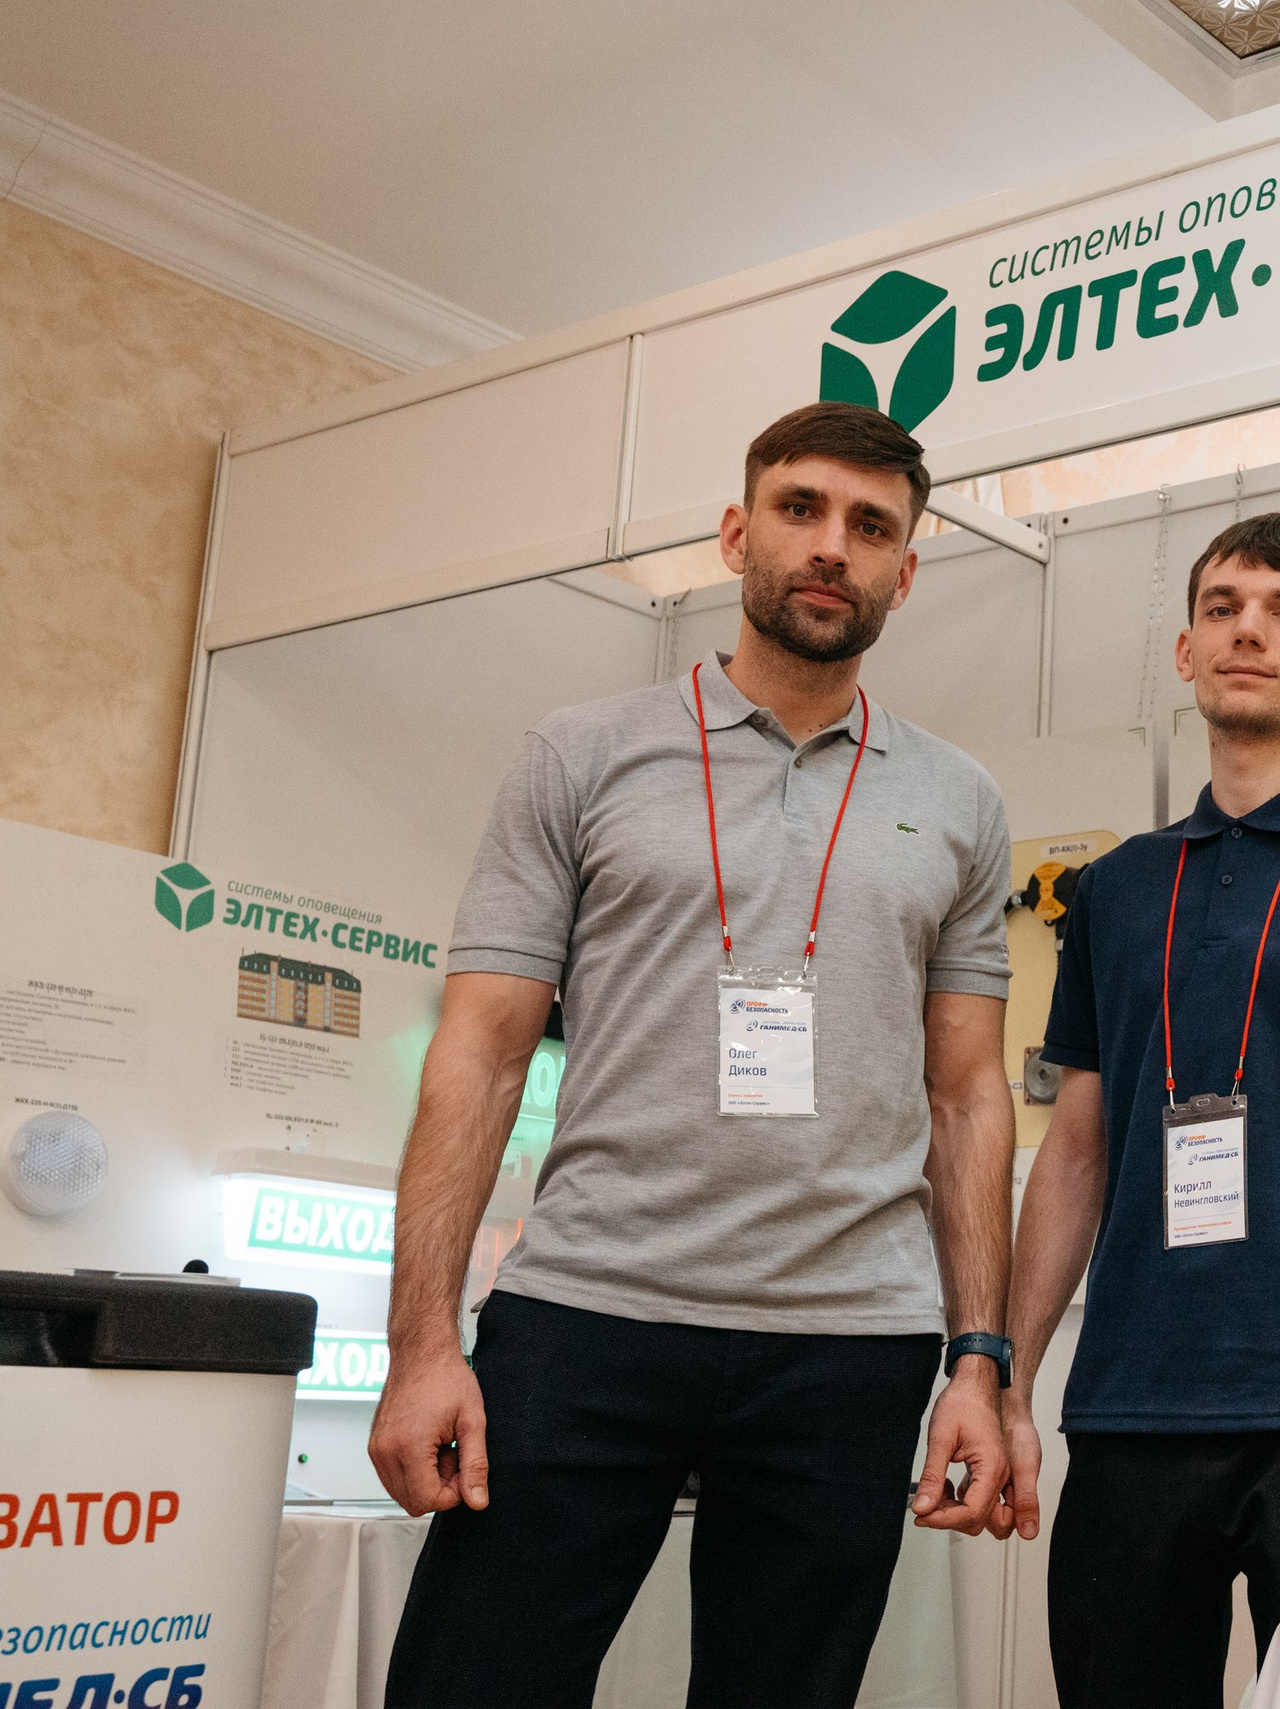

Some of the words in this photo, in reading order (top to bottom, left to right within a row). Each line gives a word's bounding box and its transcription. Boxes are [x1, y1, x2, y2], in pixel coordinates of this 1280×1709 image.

[990, 212, 1164, 290] системы
[227, 880, 294, 905] системы
[297, 895, 382, 926] оповещения
[728, 1048, 758, 1059] Олег
[728, 1065, 767, 1077] Диков
[1174, 1180, 1212, 1194] Кирилл
[1174, 1191, 1239, 1208] Невингловский
[297, 1341, 390, 1388] ХОД
[0, 1613, 212, 1656] зопасности
